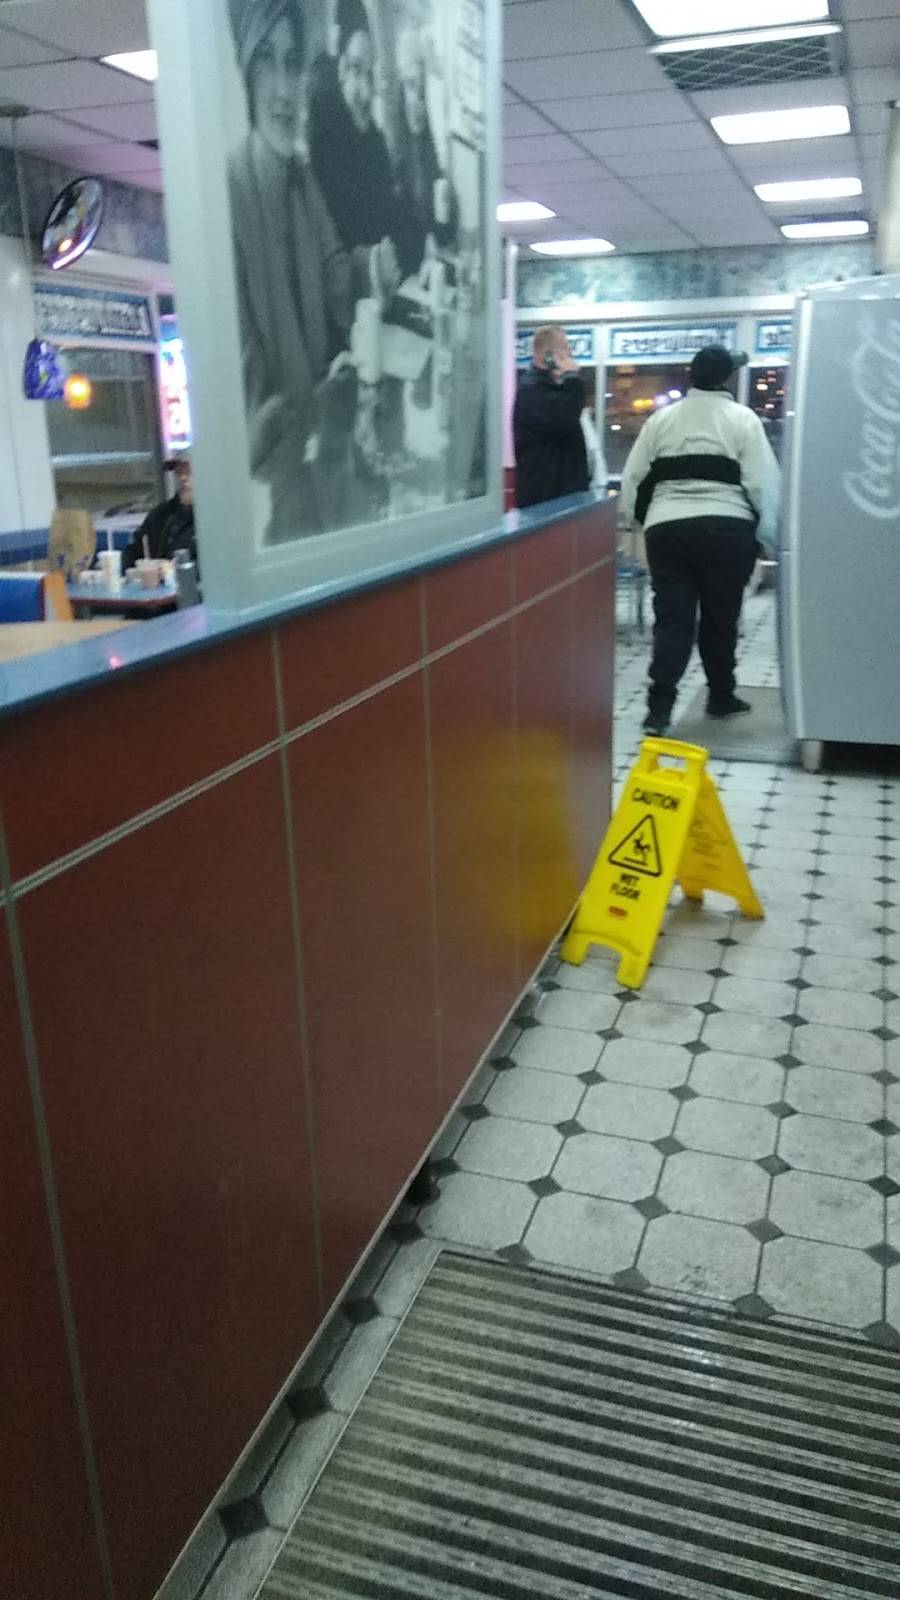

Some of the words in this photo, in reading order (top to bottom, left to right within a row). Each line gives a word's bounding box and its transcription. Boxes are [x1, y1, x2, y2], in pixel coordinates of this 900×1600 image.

[632, 788, 679, 811] CAUTION
[620, 873, 639, 886] WET
[610, 883, 640, 901] FLOOR
